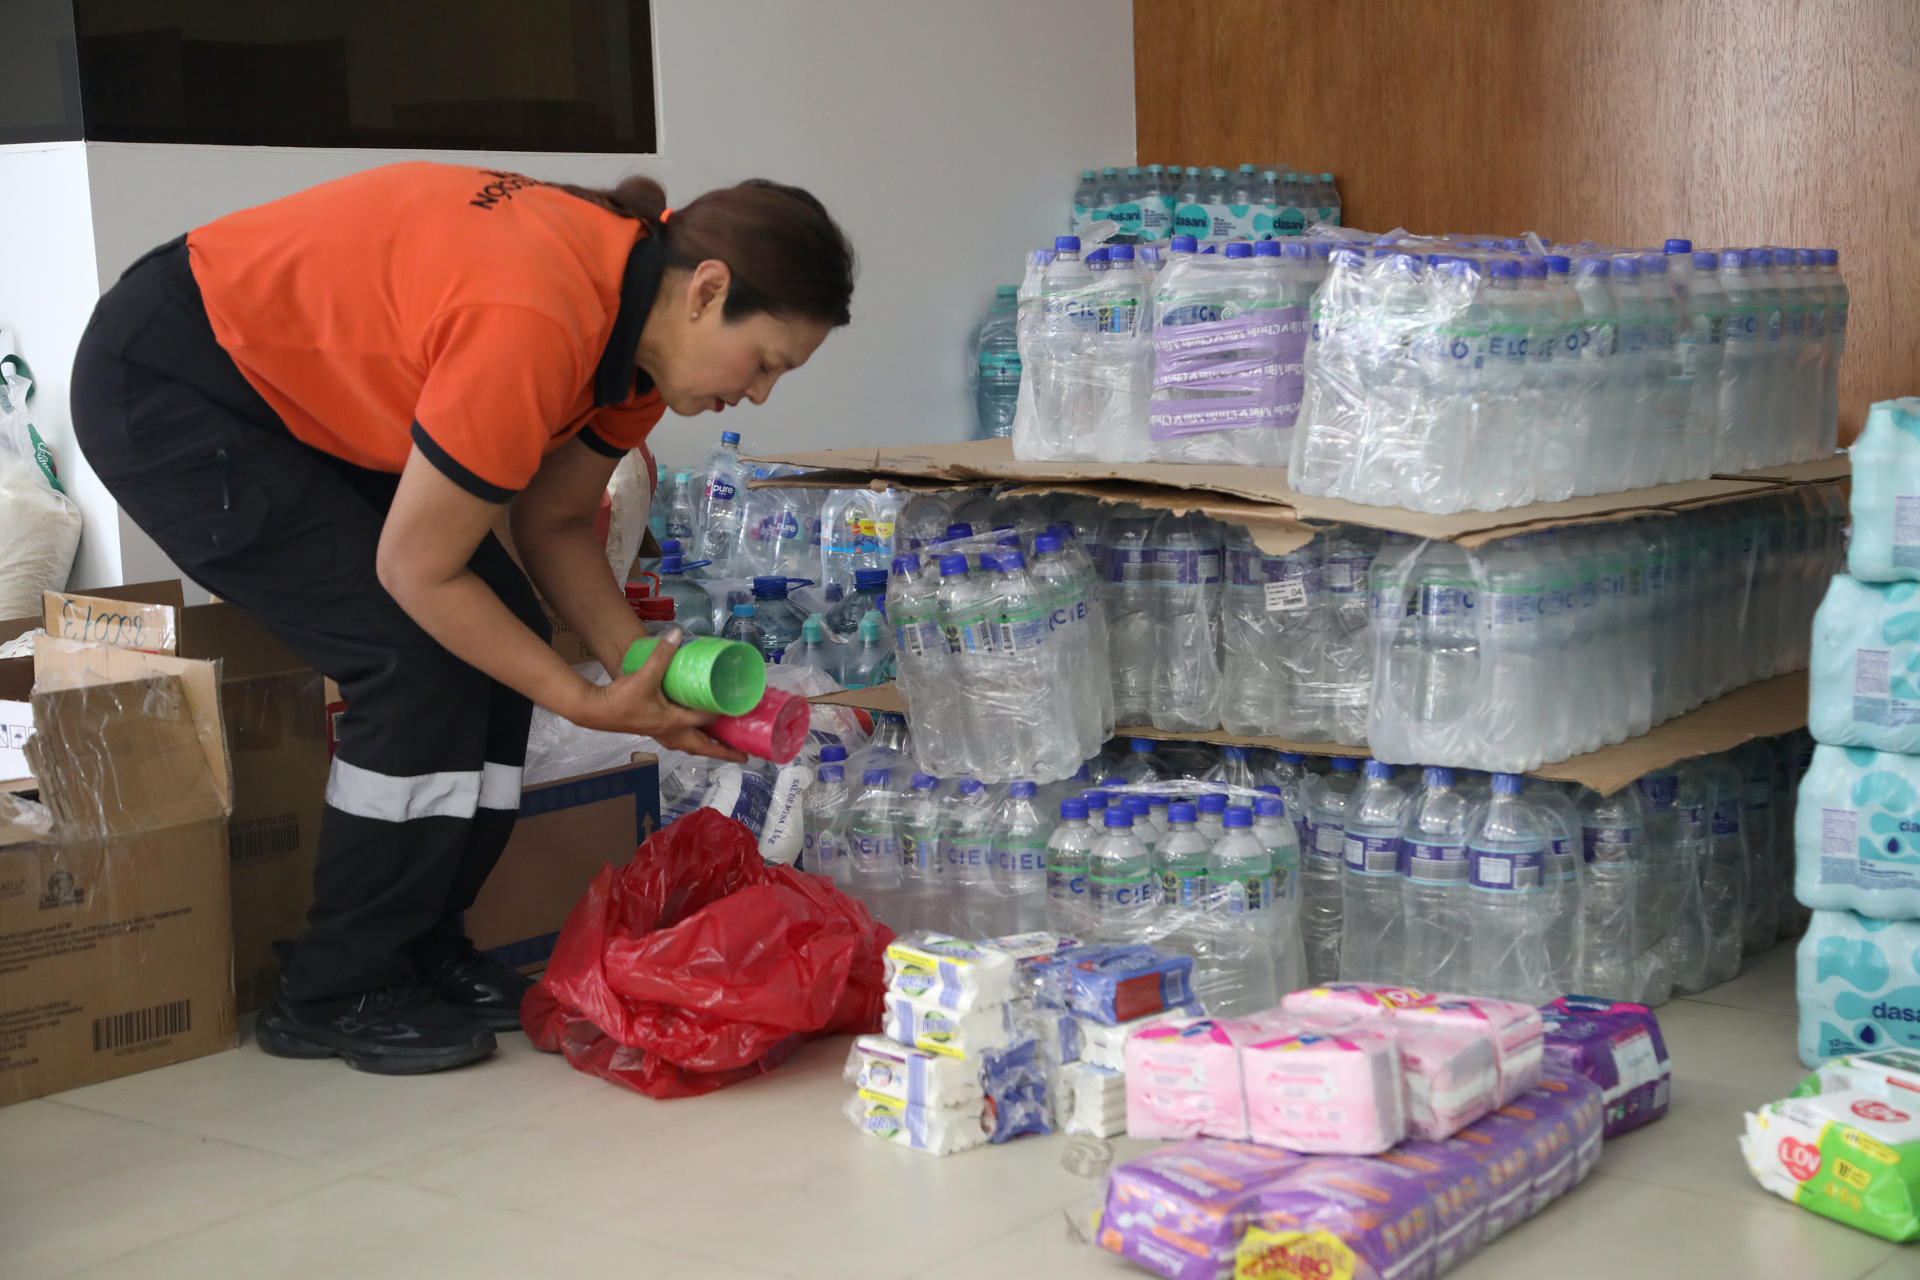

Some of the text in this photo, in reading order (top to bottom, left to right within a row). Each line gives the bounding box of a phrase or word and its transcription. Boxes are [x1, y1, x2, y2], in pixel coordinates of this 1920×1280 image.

[712, 484, 733, 494] pure
[776, 521, 796, 532] pure
[791, 778, 800, 792] SAL
[779, 804, 792, 823] MESA
[1872, 1001, 1920, 1022] das
